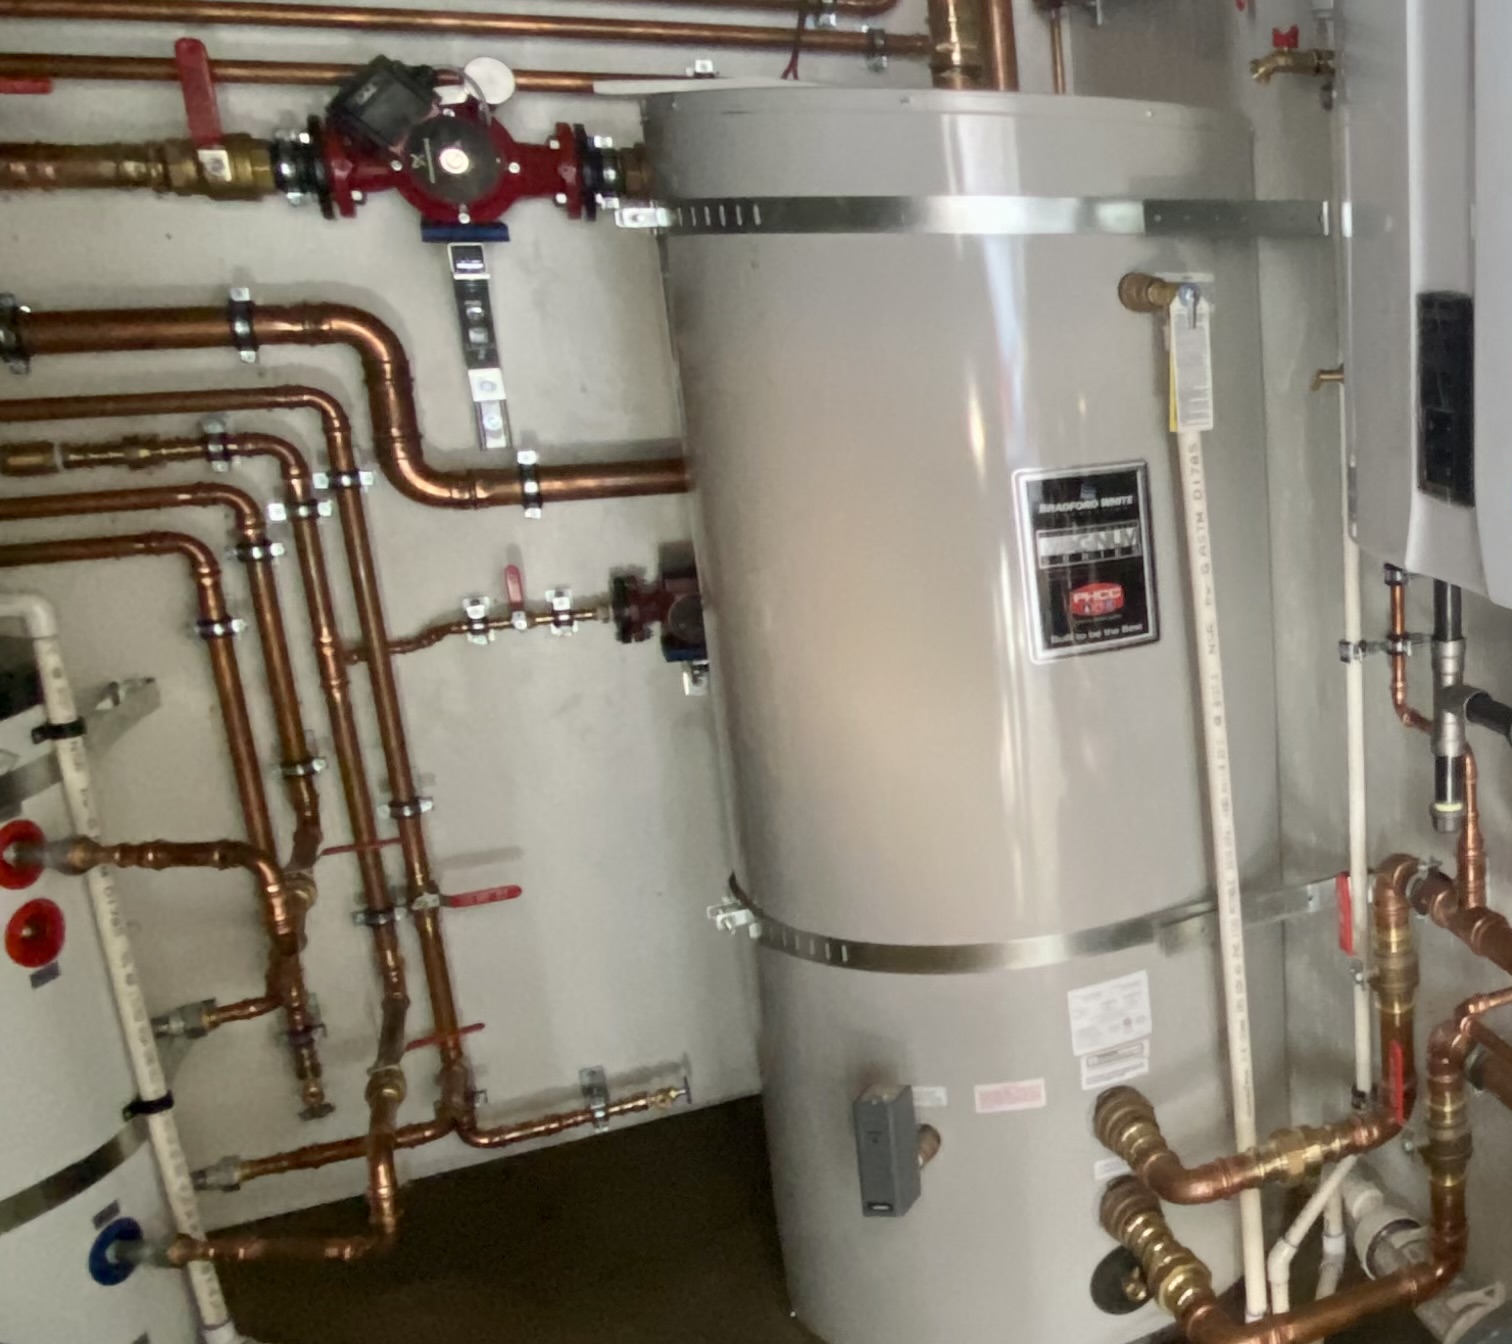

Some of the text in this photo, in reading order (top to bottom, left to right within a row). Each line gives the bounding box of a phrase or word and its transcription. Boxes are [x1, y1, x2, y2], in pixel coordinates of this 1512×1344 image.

[1039, 494, 1134, 515] BRADFORD WHITE
[1195, 511, 1210, 557] ASTM
[1121, 622, 1143, 635] Best
